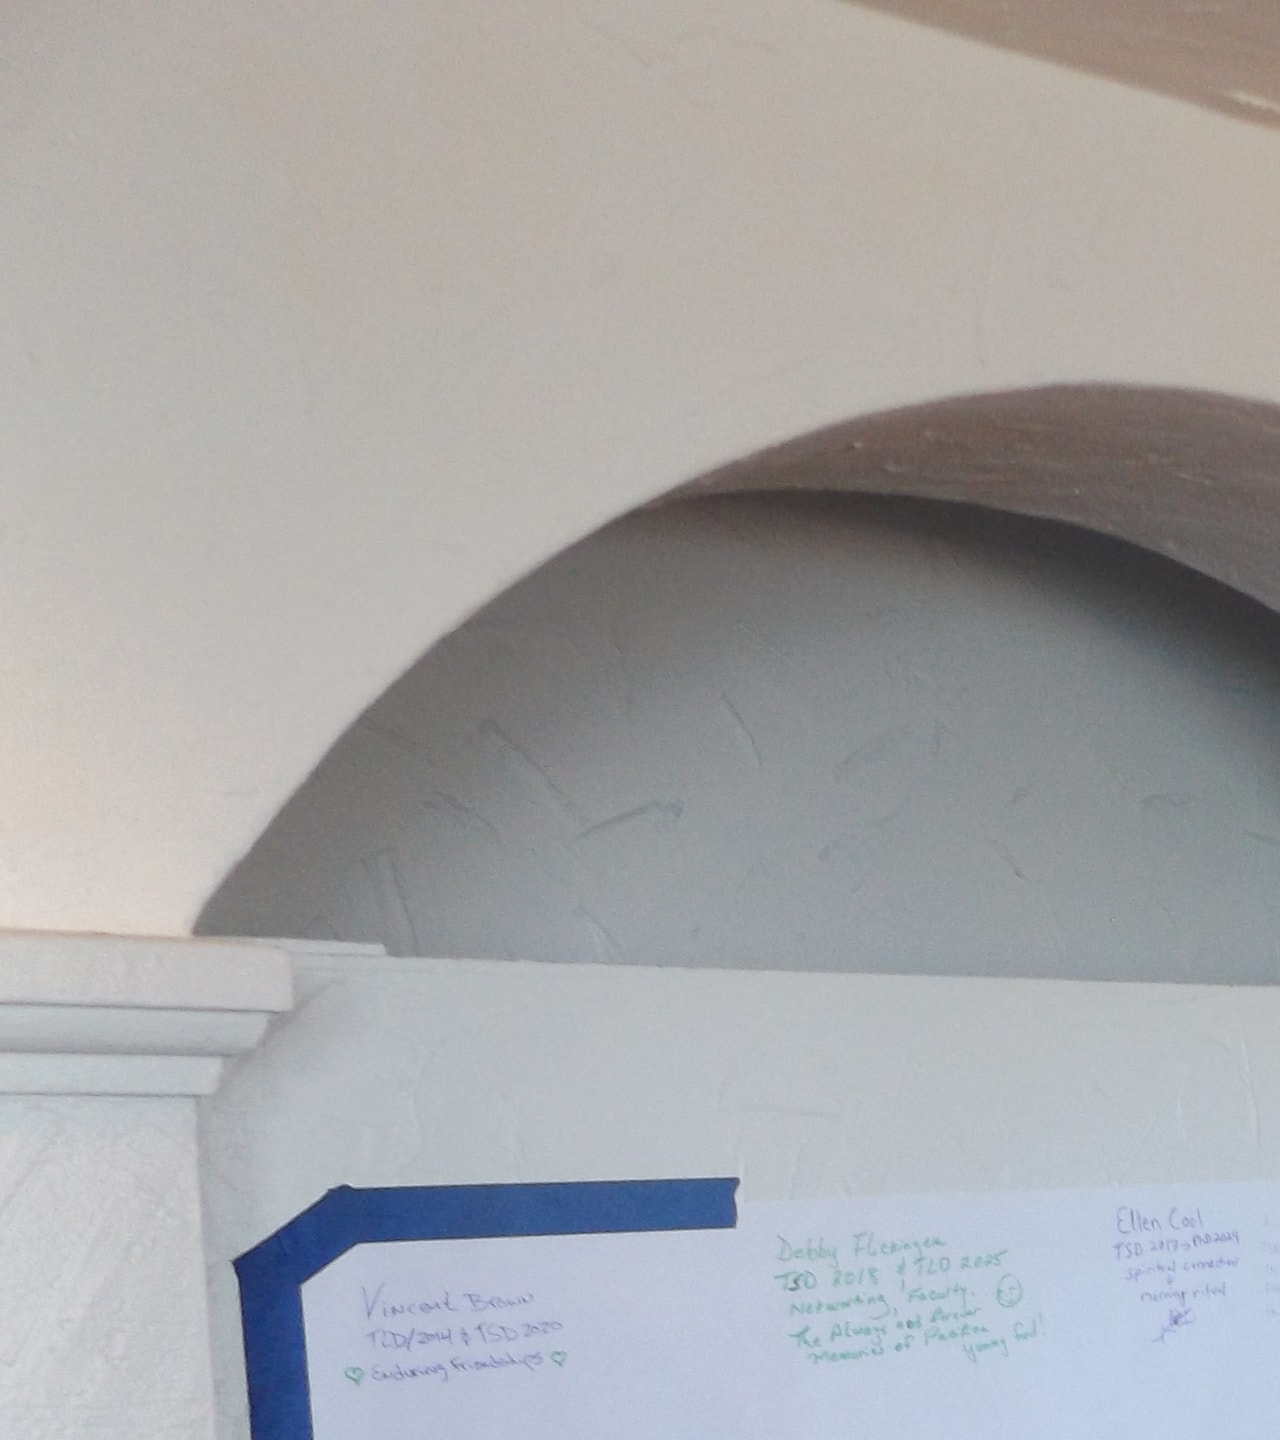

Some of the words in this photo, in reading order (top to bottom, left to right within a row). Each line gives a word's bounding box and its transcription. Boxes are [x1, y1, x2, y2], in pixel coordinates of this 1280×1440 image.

[1116, 1206, 1162, 1234] Ellen
[776, 1234, 838, 1268] Debby
[1113, 1243, 1144, 1261] TSD
[831, 1266, 880, 1288] 2018
